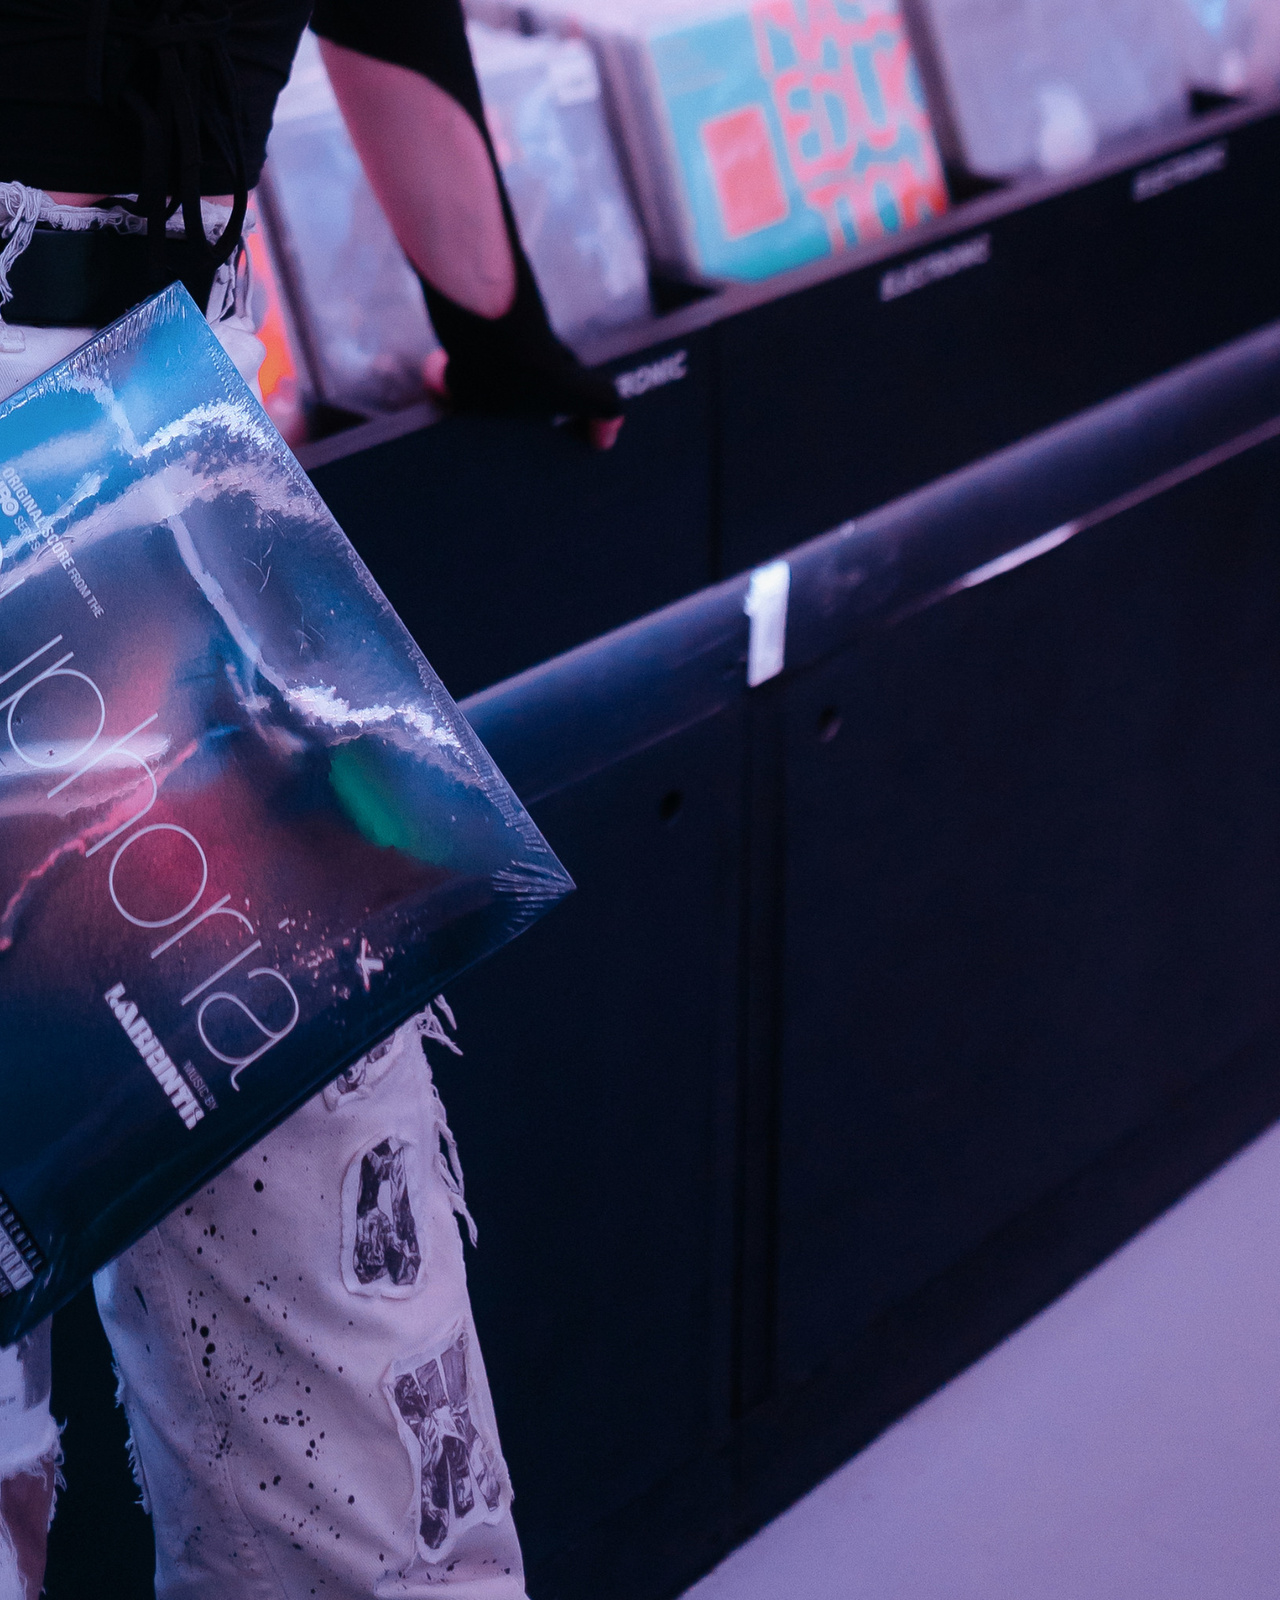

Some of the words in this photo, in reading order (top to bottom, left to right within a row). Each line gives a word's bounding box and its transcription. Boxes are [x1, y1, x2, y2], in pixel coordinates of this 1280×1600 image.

[1, 466, 46, 529] ORIGINAL
[41, 526, 75, 572] SCORE
[67, 565, 93, 601] FROM
[85, 596, 107, 621] THE
[13, 514, 42, 552] SERIES
[181, 1059, 212, 1100] MUSIC
[204, 1092, 220, 1113] BY
